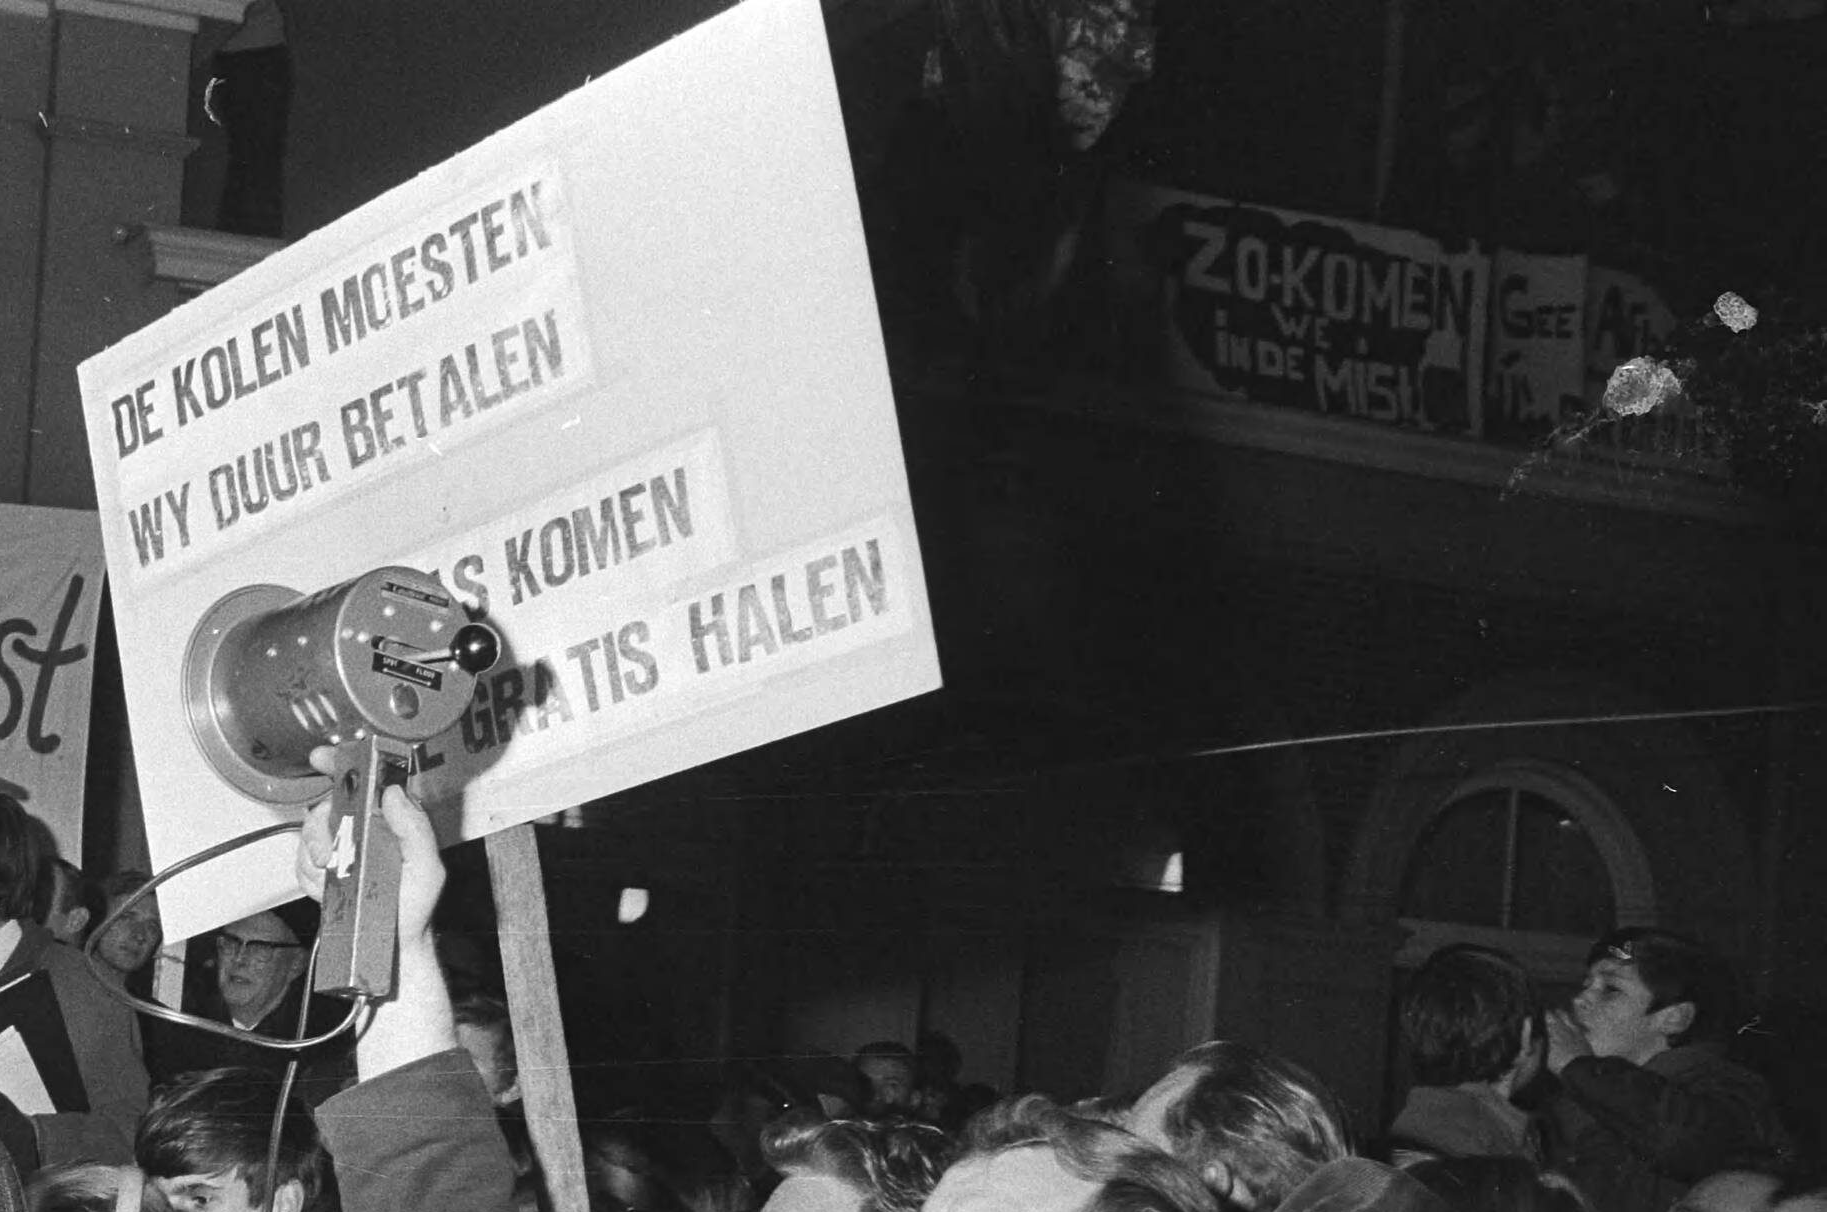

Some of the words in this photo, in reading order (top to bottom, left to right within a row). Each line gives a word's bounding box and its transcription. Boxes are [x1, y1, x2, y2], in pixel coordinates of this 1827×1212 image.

[111, 380, 163, 460] DE
[172, 304, 311, 428] KOLEN
[320, 181, 553, 355] MOESTEN
[1256, 339, 1306, 381] DE
[1271, 302, 1331, 350] WE
[128, 482, 191, 568] WY
[208, 420, 332, 531] DUUR
[341, 308, 565, 470] BETALEN
[505, 466, 694, 606] KOMEN
[460, 620, 660, 755] GRATIS
[688, 537, 888, 673] HALEN
